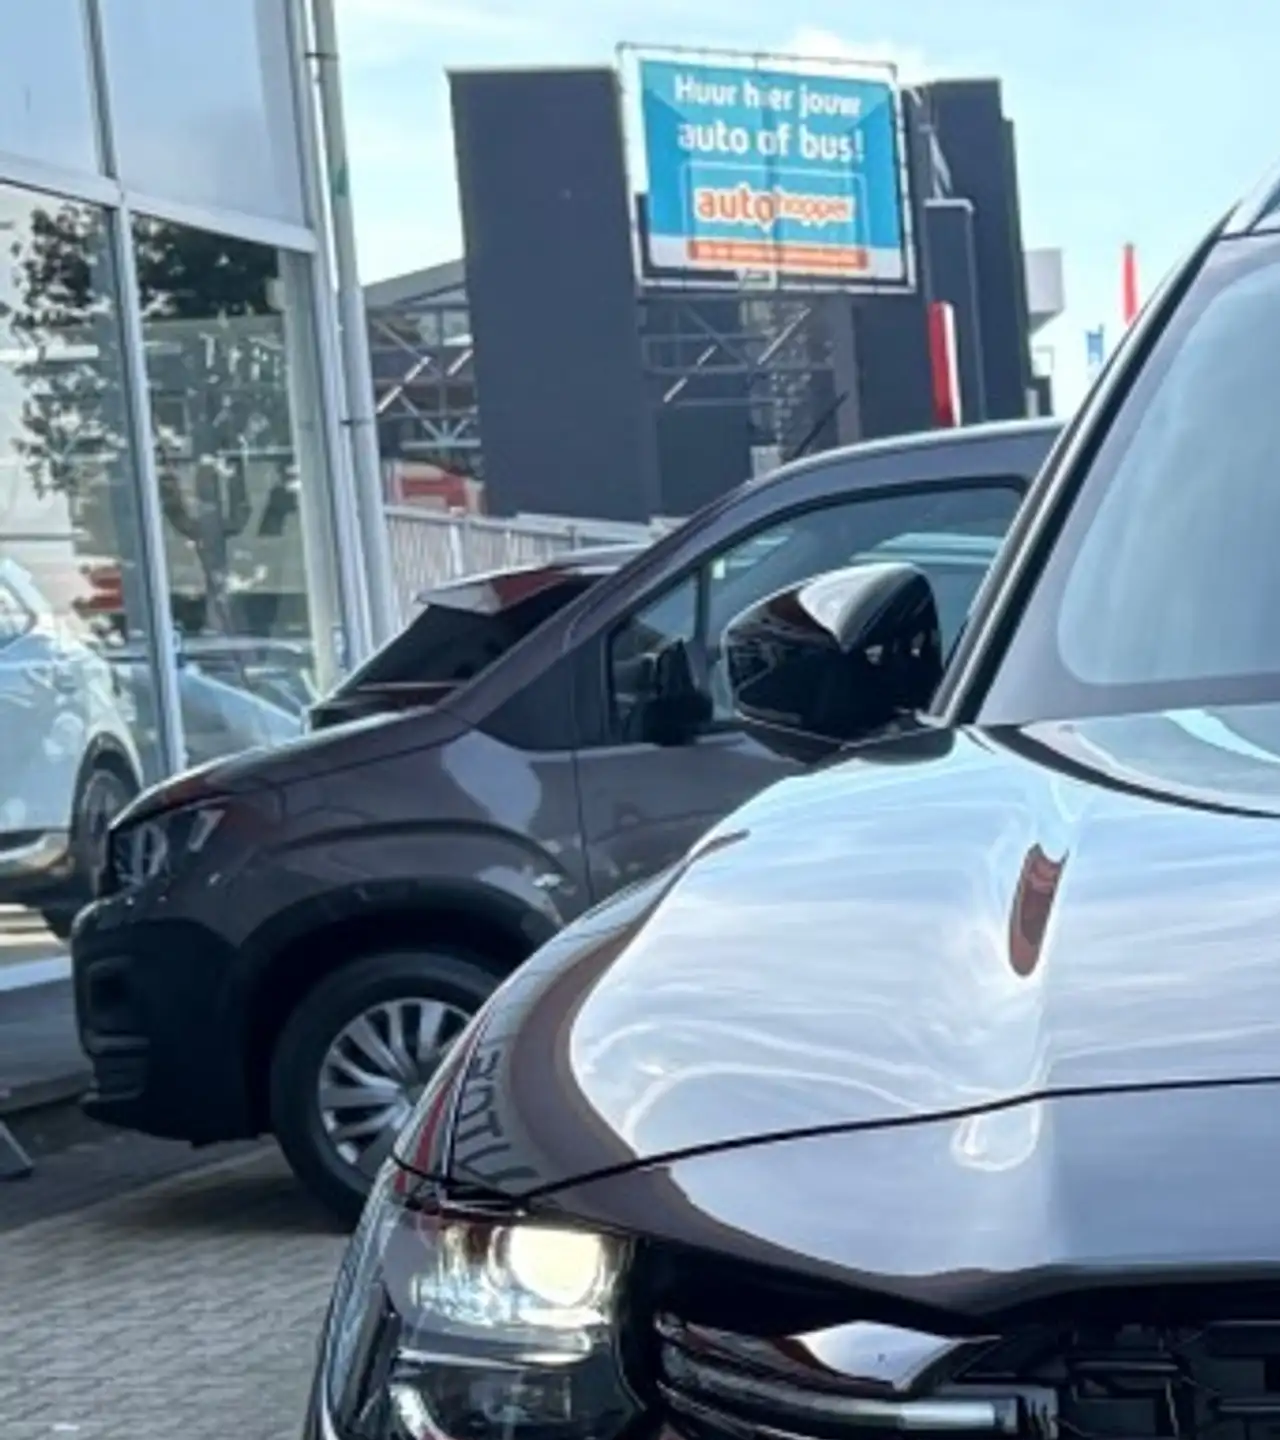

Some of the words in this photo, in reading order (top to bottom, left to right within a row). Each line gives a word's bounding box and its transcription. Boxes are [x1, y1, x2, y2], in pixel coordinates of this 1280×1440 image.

[675, 75, 736, 106] Huur
[800, 83, 861, 118] jouw
[678, 120, 748, 154] auto
[757, 122, 790, 156] of
[799, 124, 865, 163] bus!
